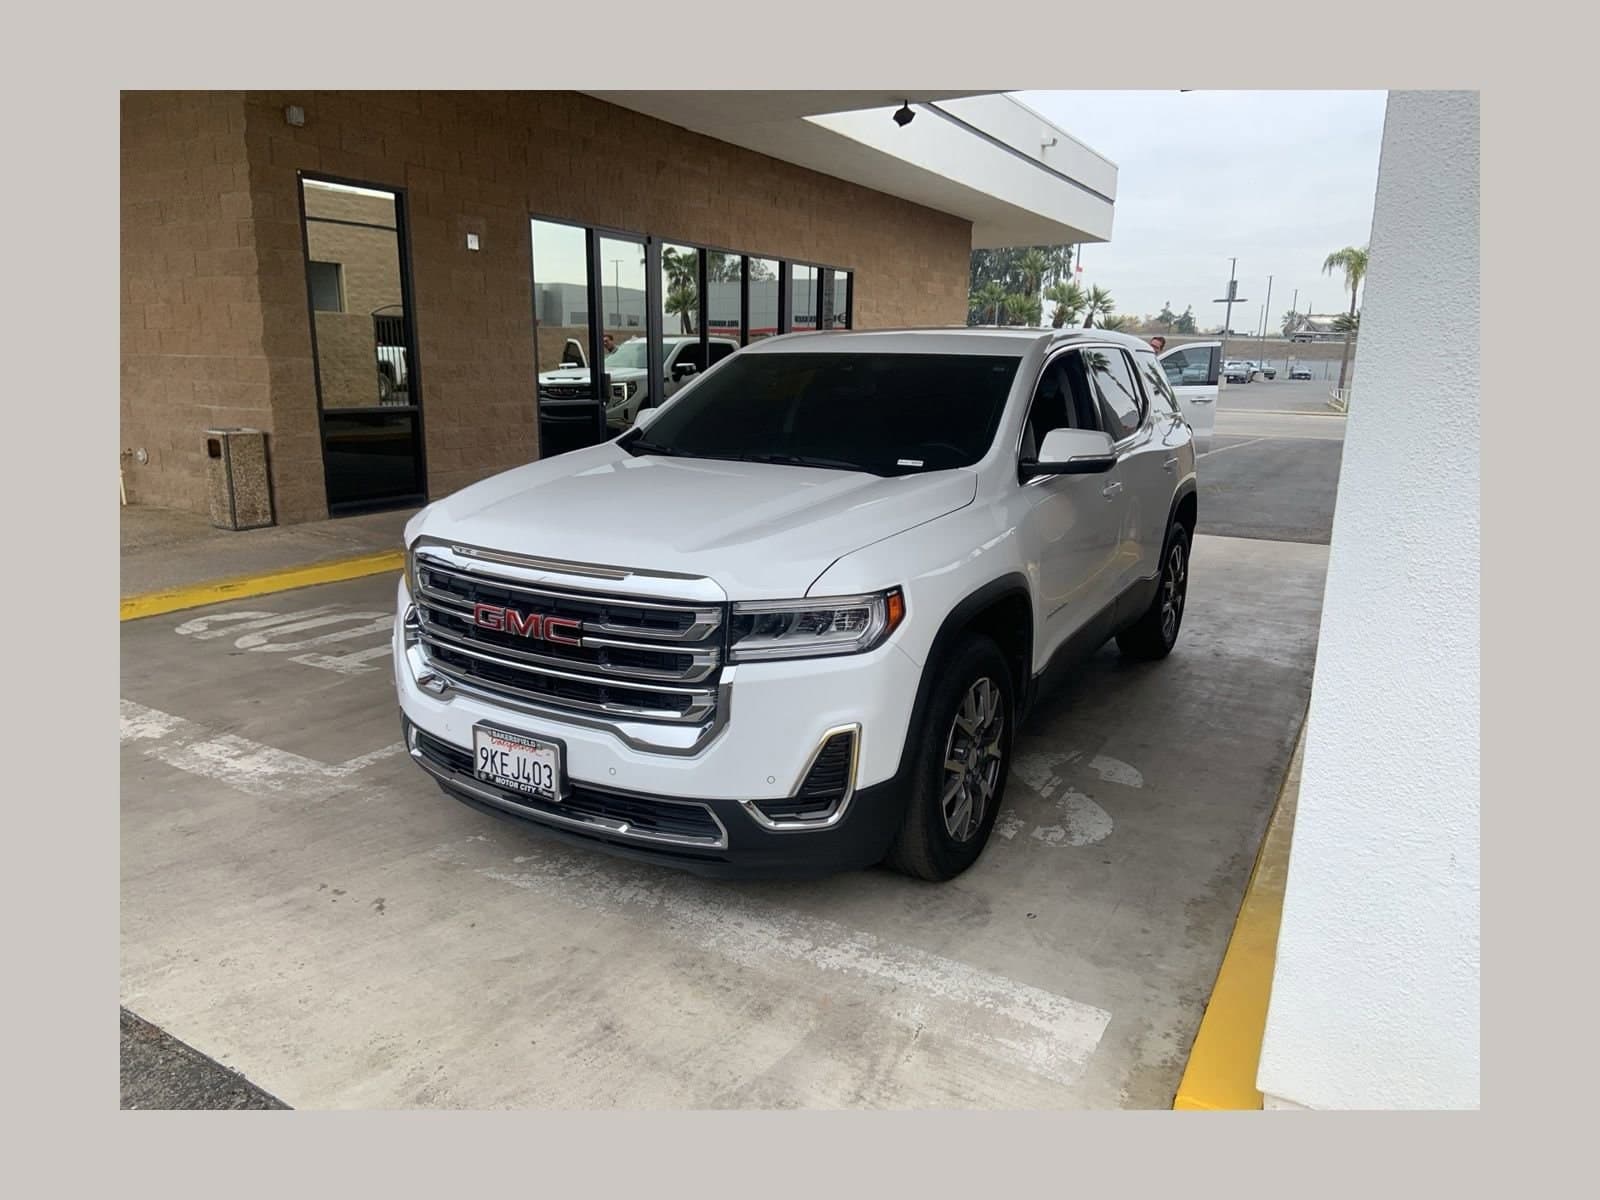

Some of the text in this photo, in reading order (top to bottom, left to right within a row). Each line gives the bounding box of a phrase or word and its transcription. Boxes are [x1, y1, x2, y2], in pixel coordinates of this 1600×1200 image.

[474, 603, 582, 647] GMC
[480, 746, 553, 789] 9KEJ403
[495, 777, 537, 794] MOTOR CITY
